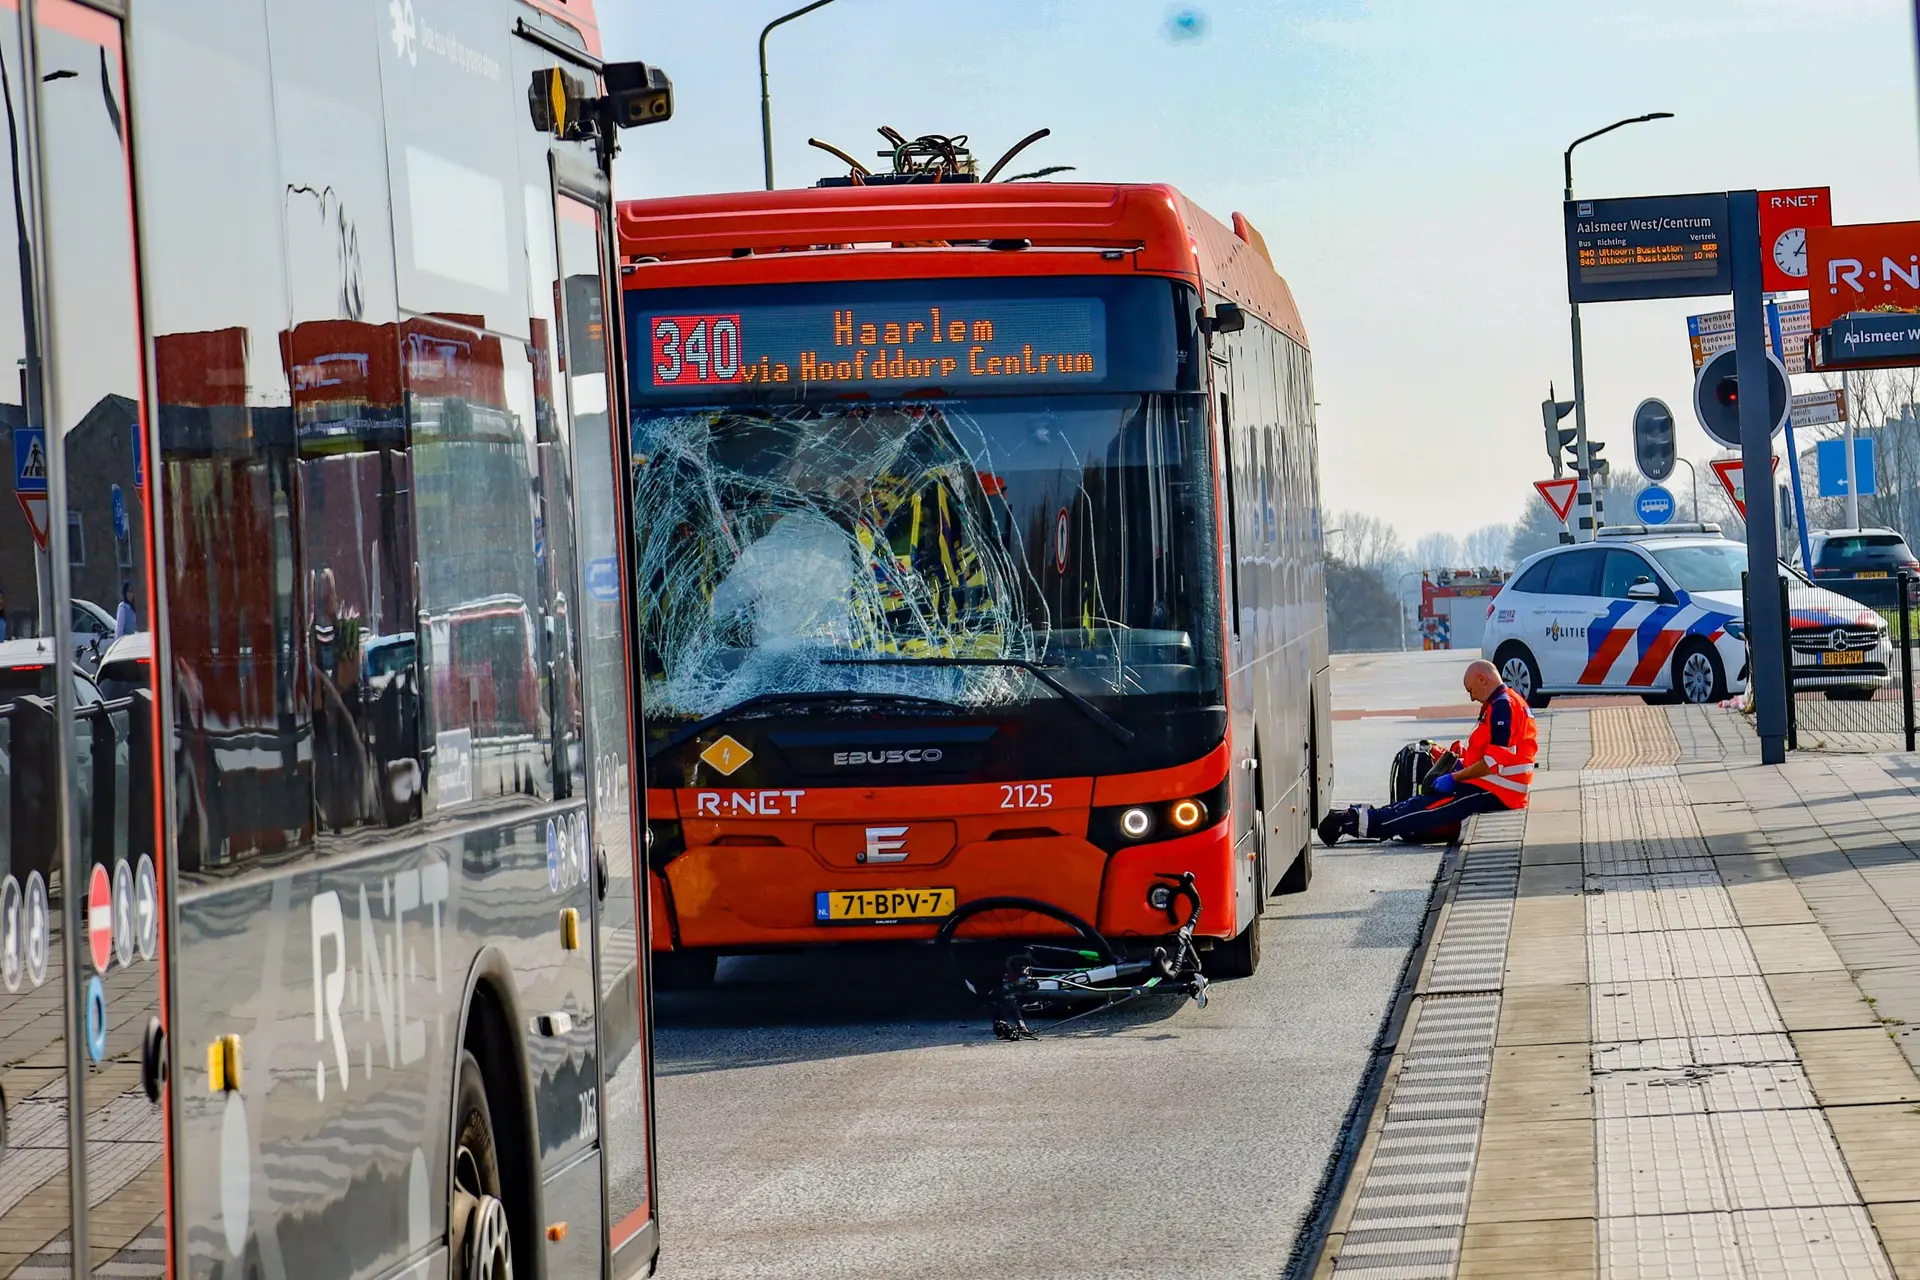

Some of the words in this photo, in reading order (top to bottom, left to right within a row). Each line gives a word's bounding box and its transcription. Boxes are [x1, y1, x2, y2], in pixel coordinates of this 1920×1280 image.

[1577, 221, 1628, 233] Aalsmeer
[1630, 217, 1711, 231] West/Centrum
[1597, 238, 1627, 247] Richting
[1690, 233, 1716, 241] Vertrek
[1599, 248, 1634, 257] Uithoorn
[1637, 245, 1683, 254] Busstation
[1599, 256, 1635, 265] Uithoorn
[1637, 253, 1683, 262] Busstation
[834, 307, 993, 346] Haarlem
[1699, 313, 1731, 324] Zwembad
[1699, 324, 1711, 332] het
[1844, 330, 1904, 343] Aalsmeer
[655, 320, 738, 381] 340
[741, 357, 788, 383] via
[801, 349, 957, 381] Hoofddorp
[968, 345, 1093, 376] Centrum
[1546, 623, 1585, 641] POLITIE
[833, 748, 942, 765] EBUSCO
[1000, 784, 1053, 808] 2125
[842, 892, 942, 915] 71-BPV-7
